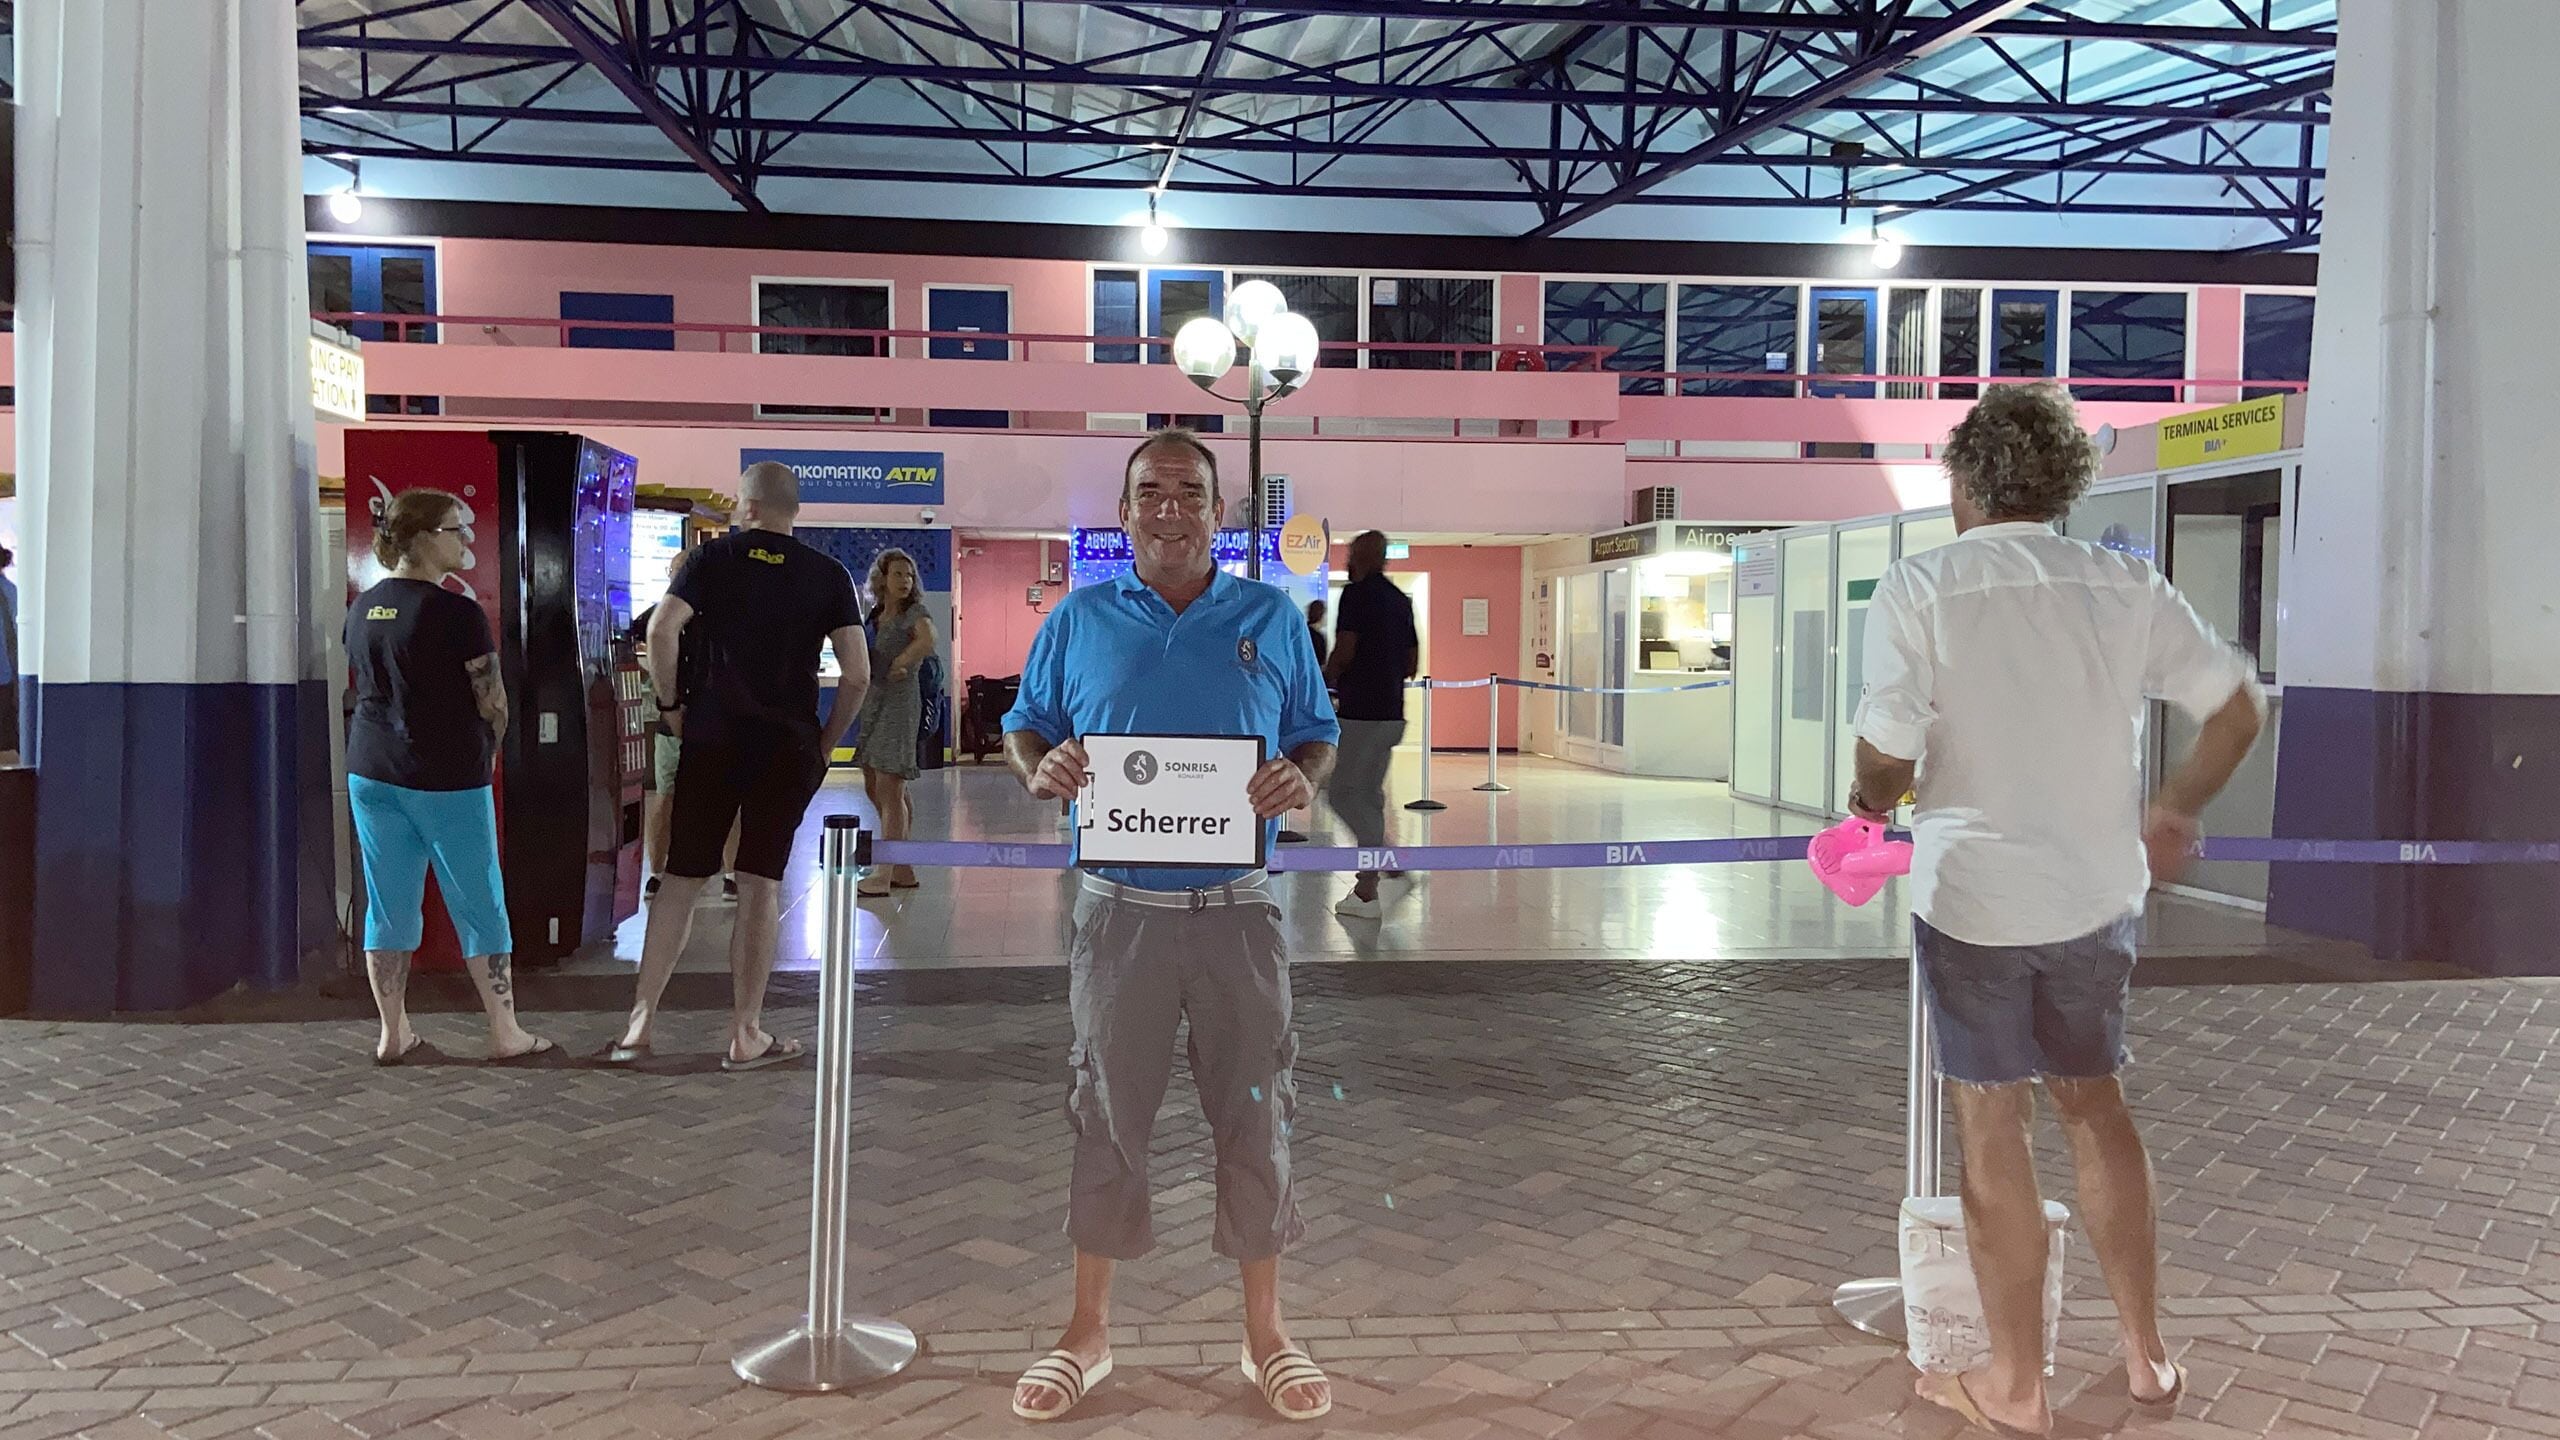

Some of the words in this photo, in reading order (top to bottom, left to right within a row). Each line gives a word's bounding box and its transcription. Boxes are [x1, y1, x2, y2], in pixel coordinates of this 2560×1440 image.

[310, 346, 336, 376] ING
[339, 356, 359, 381] PAY
[2164, 417, 2219, 440] TERMINAL
[2222, 405, 2276, 430] SERVICES
[885, 467, 937, 481] ATM
[826, 479, 881, 489] banking
[1594, 539, 1615, 558] Airport
[1615, 534, 1639, 553] Security
[1165, 762, 1218, 773] SONRISA
[1107, 808, 1231, 835] Scherrer
[1357, 850, 1398, 869] BIA
[1606, 845, 1647, 864] BIA
[2400, 843, 2437, 862] BIA
